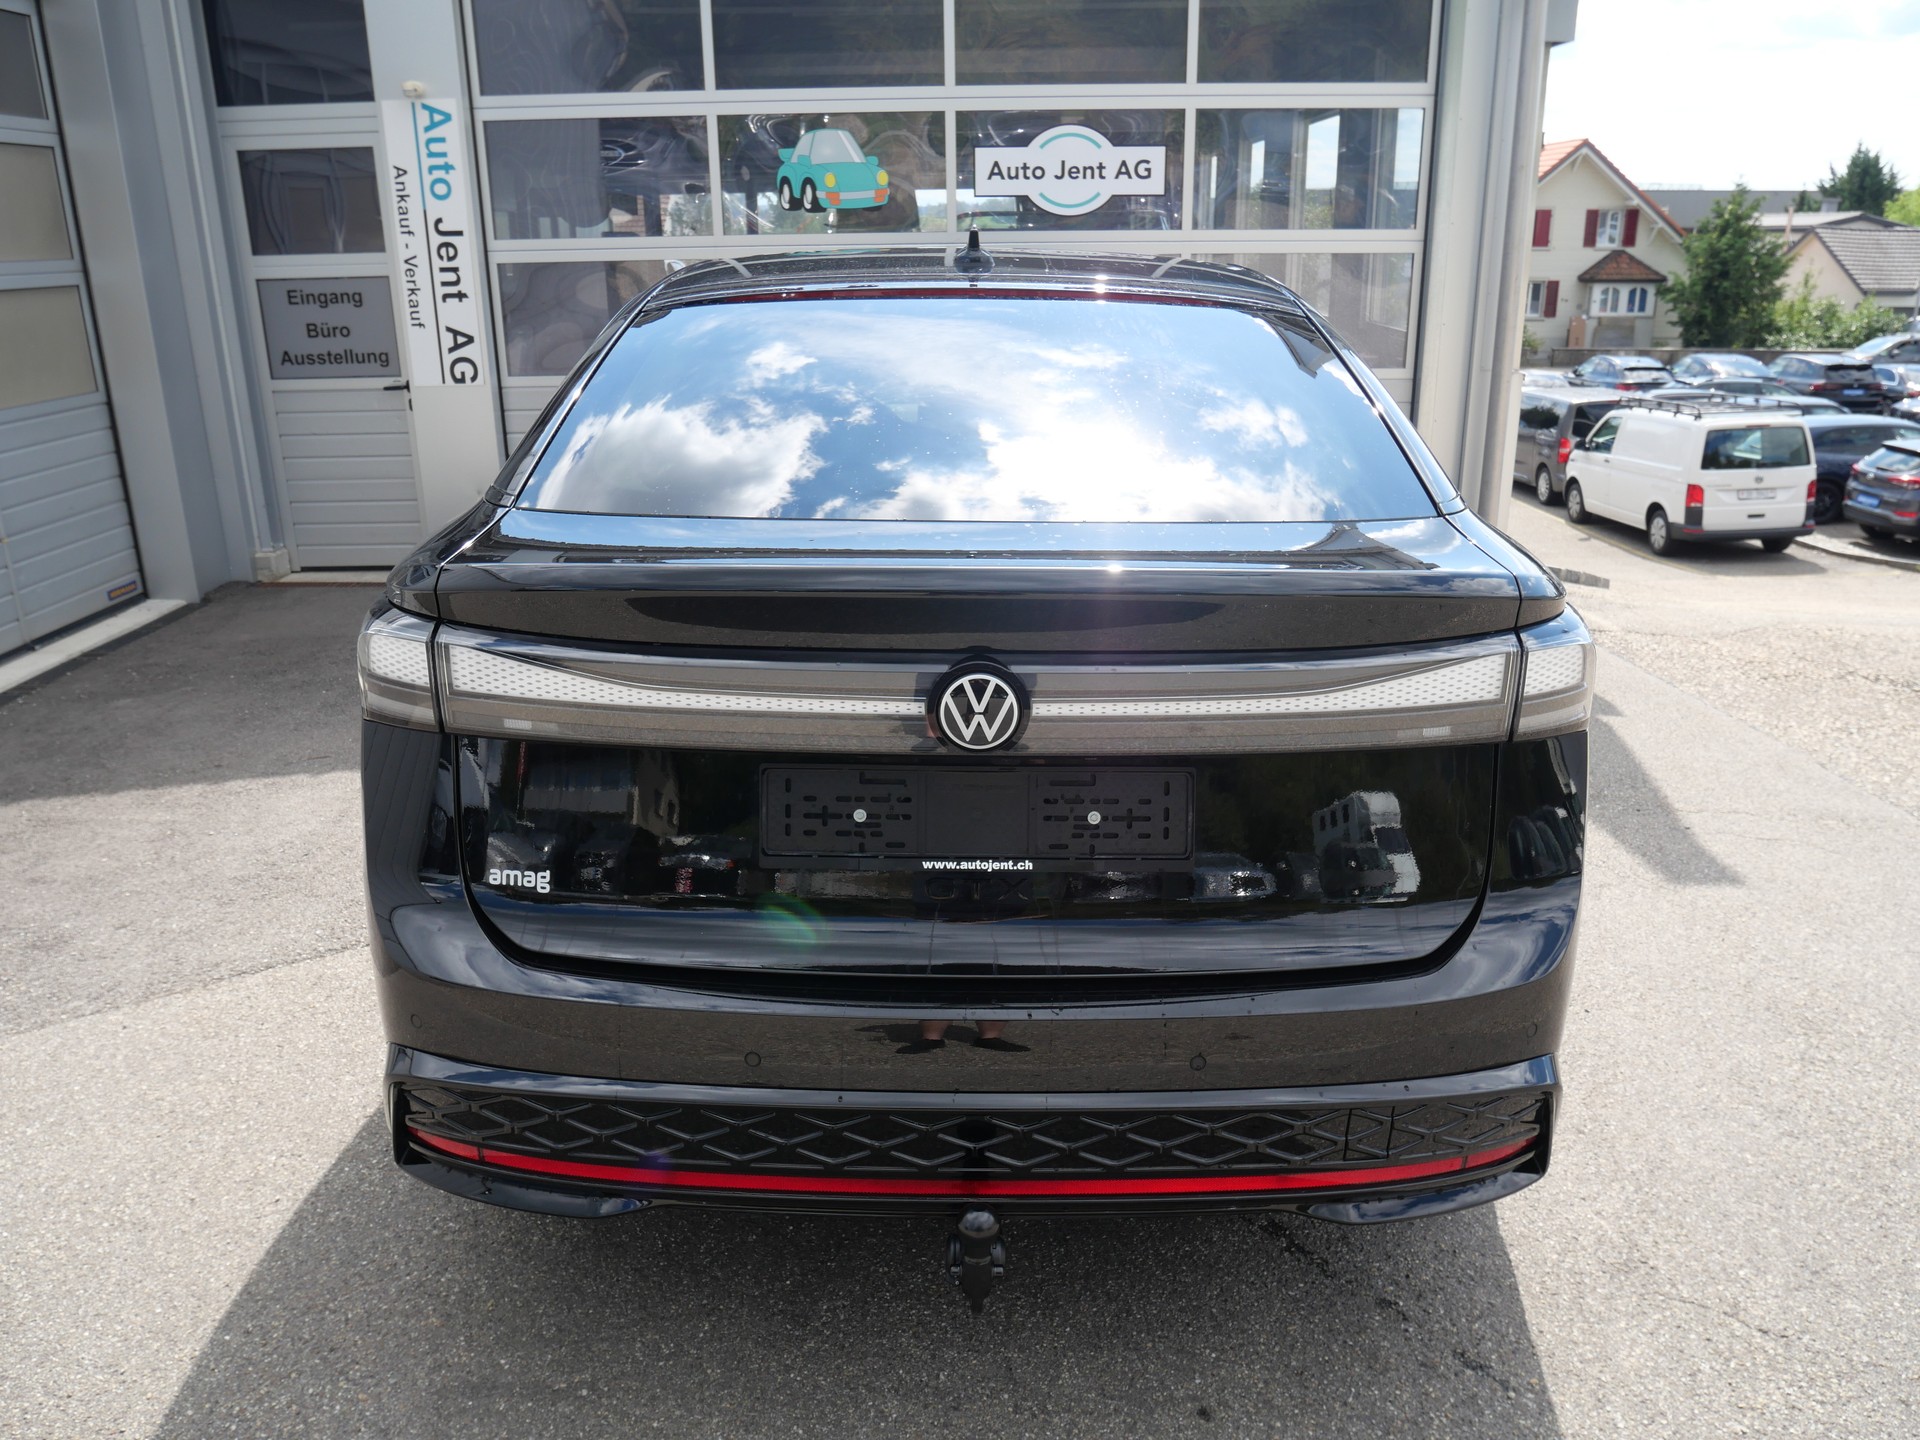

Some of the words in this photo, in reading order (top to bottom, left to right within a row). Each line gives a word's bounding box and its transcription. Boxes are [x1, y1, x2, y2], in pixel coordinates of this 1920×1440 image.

[420, 102, 456, 202] Auto
[986, 160, 1046, 181] Auto
[1054, 159, 1107, 181] Jent
[1114, 159, 1153, 181] AG
[392, 164, 415, 237] Ankauf
[433, 217, 469, 304] Jent
[286, 289, 363, 309] Eingang
[403, 255, 426, 329] Verkauf
[305, 322, 351, 339] Büro
[280, 349, 390, 369] Ausstellung
[445, 325, 479, 385] AG
[940, 674, 1019, 750] VW
[488, 868, 551, 894] amag
[921, 859, 1034, 872] www.autojent.ch
